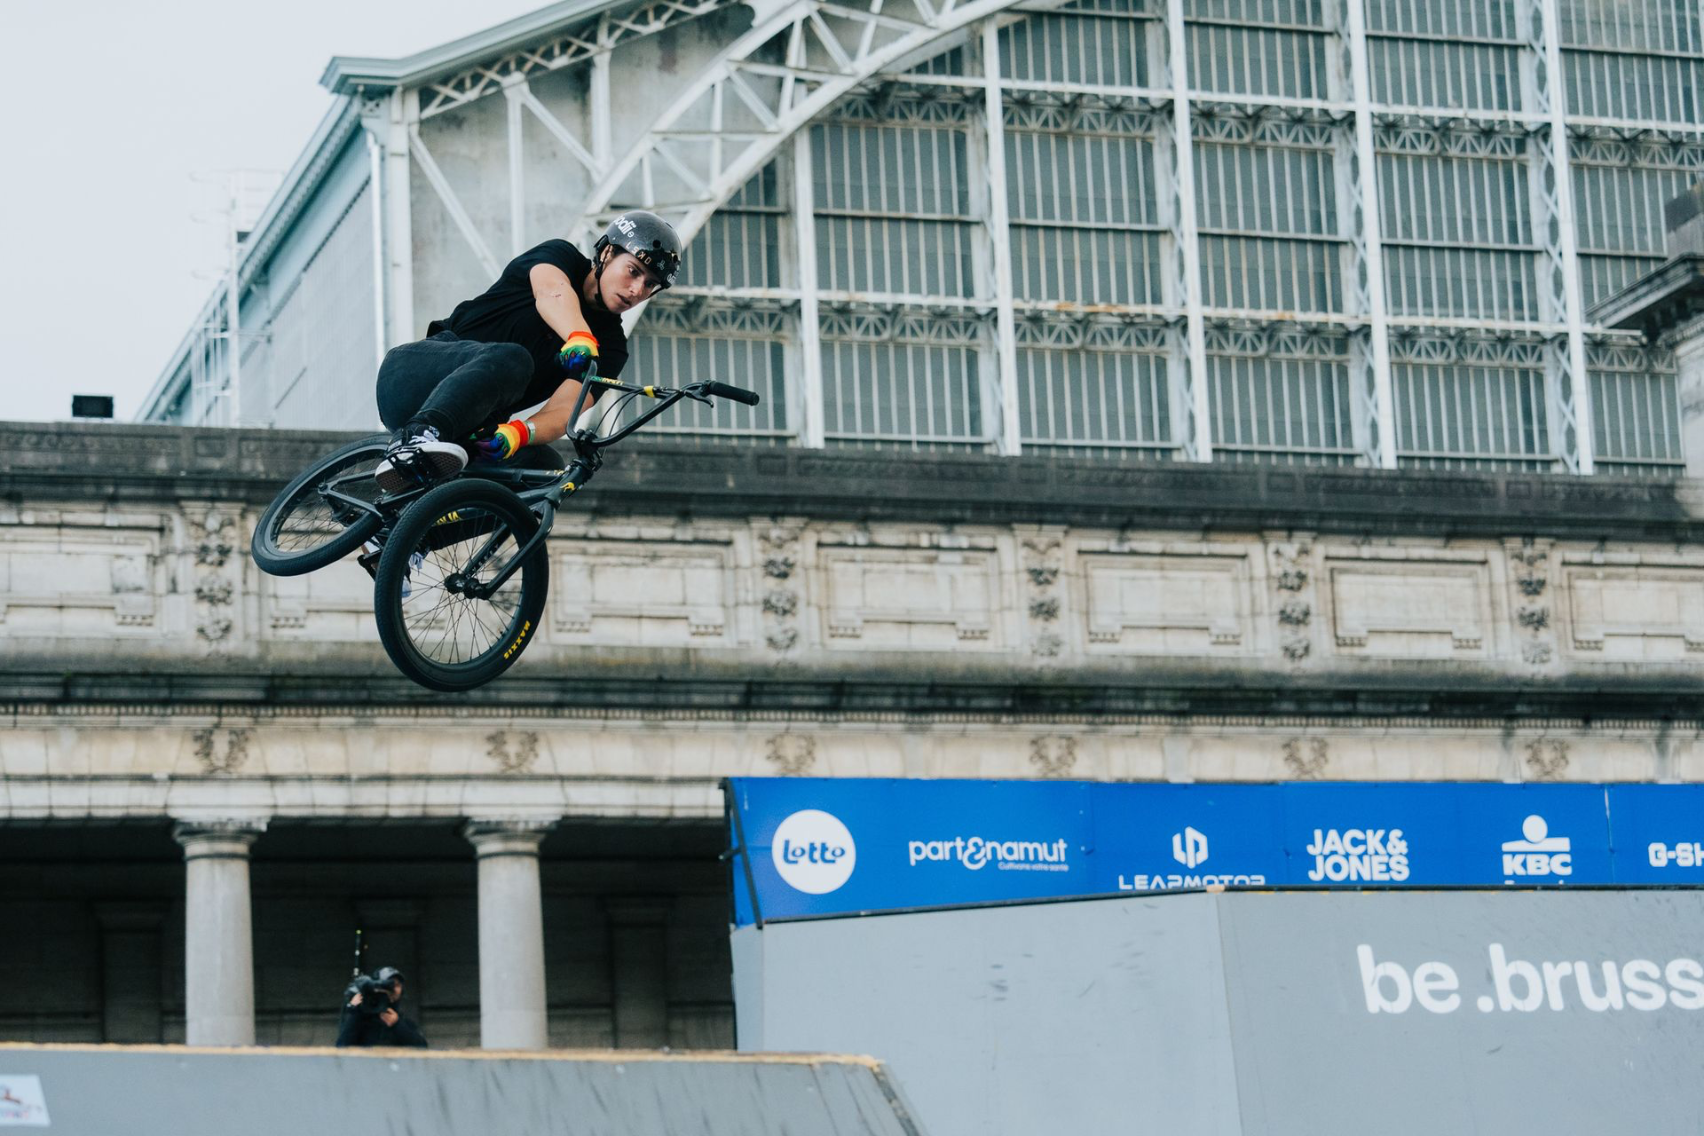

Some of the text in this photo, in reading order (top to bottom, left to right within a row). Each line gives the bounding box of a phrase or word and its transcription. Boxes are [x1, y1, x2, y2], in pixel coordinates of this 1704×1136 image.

[503, 620, 530, 659] MAXXIS
[1308, 855, 1410, 881] JONES
[1503, 854, 1572, 875] KBC
